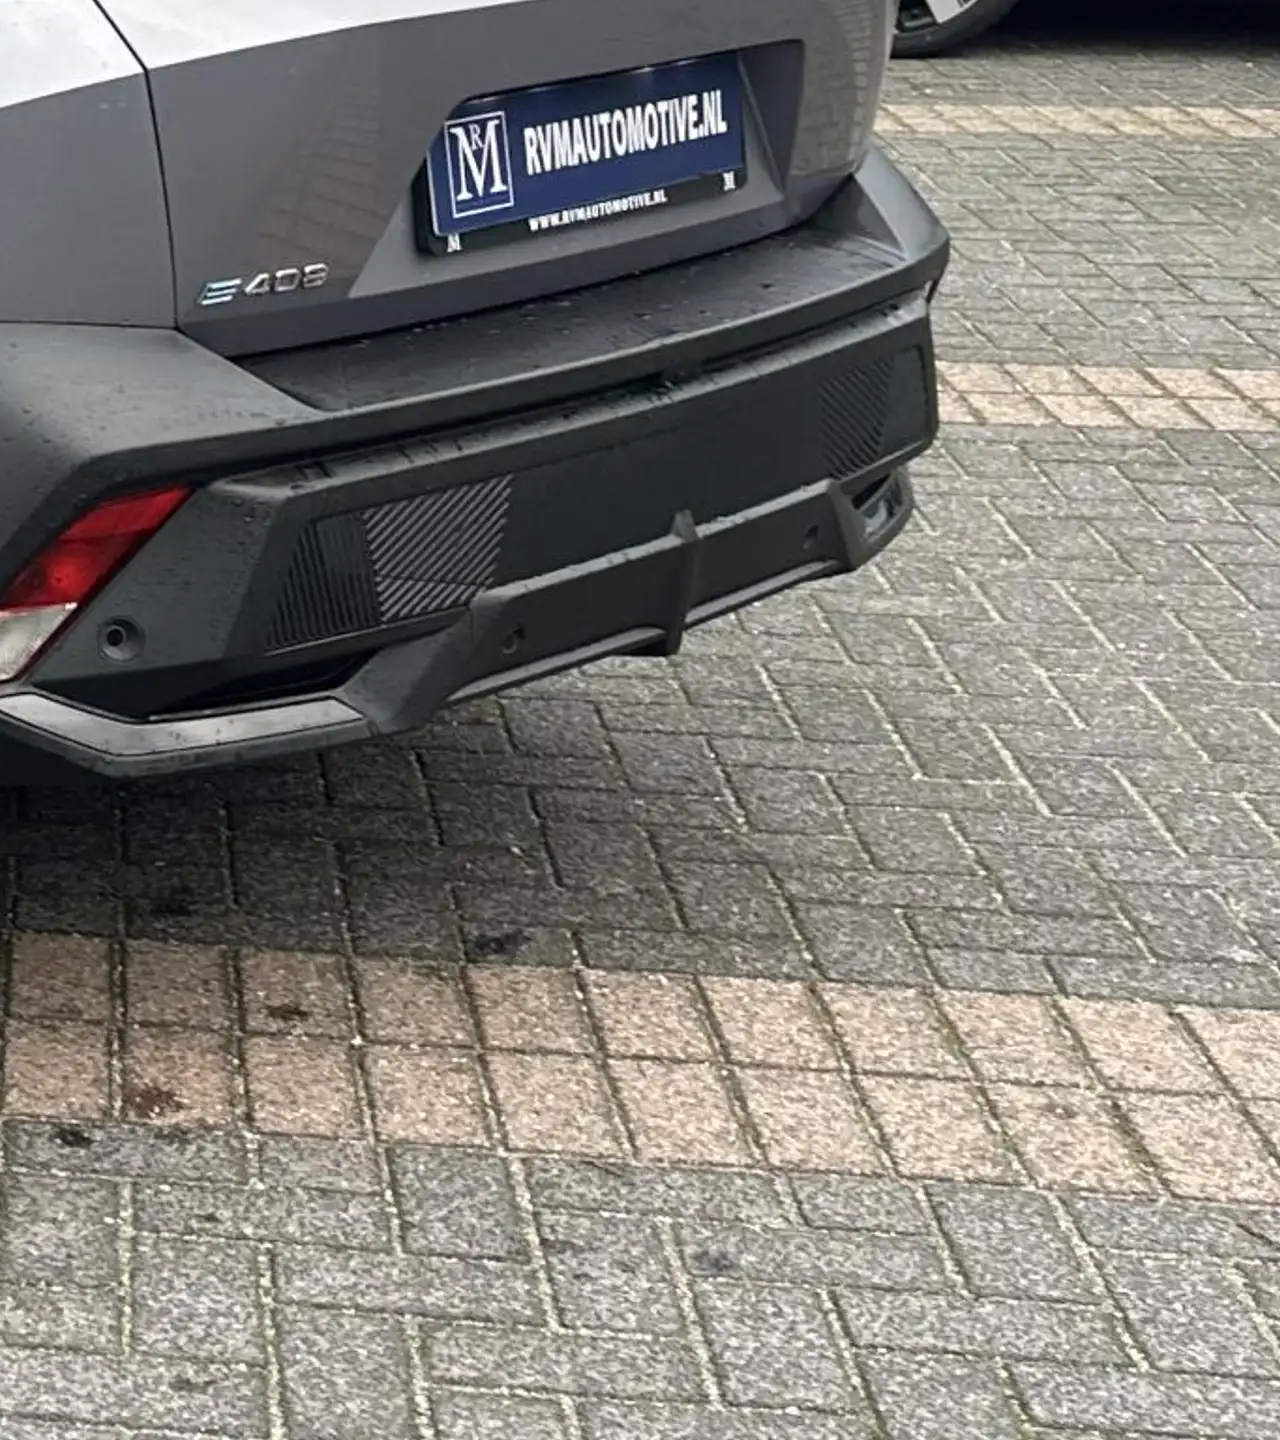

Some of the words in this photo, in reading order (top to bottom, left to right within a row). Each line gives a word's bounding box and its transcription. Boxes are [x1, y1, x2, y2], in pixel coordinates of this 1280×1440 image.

[450, 119, 508, 201] M
[523, 88, 728, 176] RVMAUTOMOTIVE.NL
[528, 188, 669, 232] WWW.RVMAUTOMOTIVE.NL
